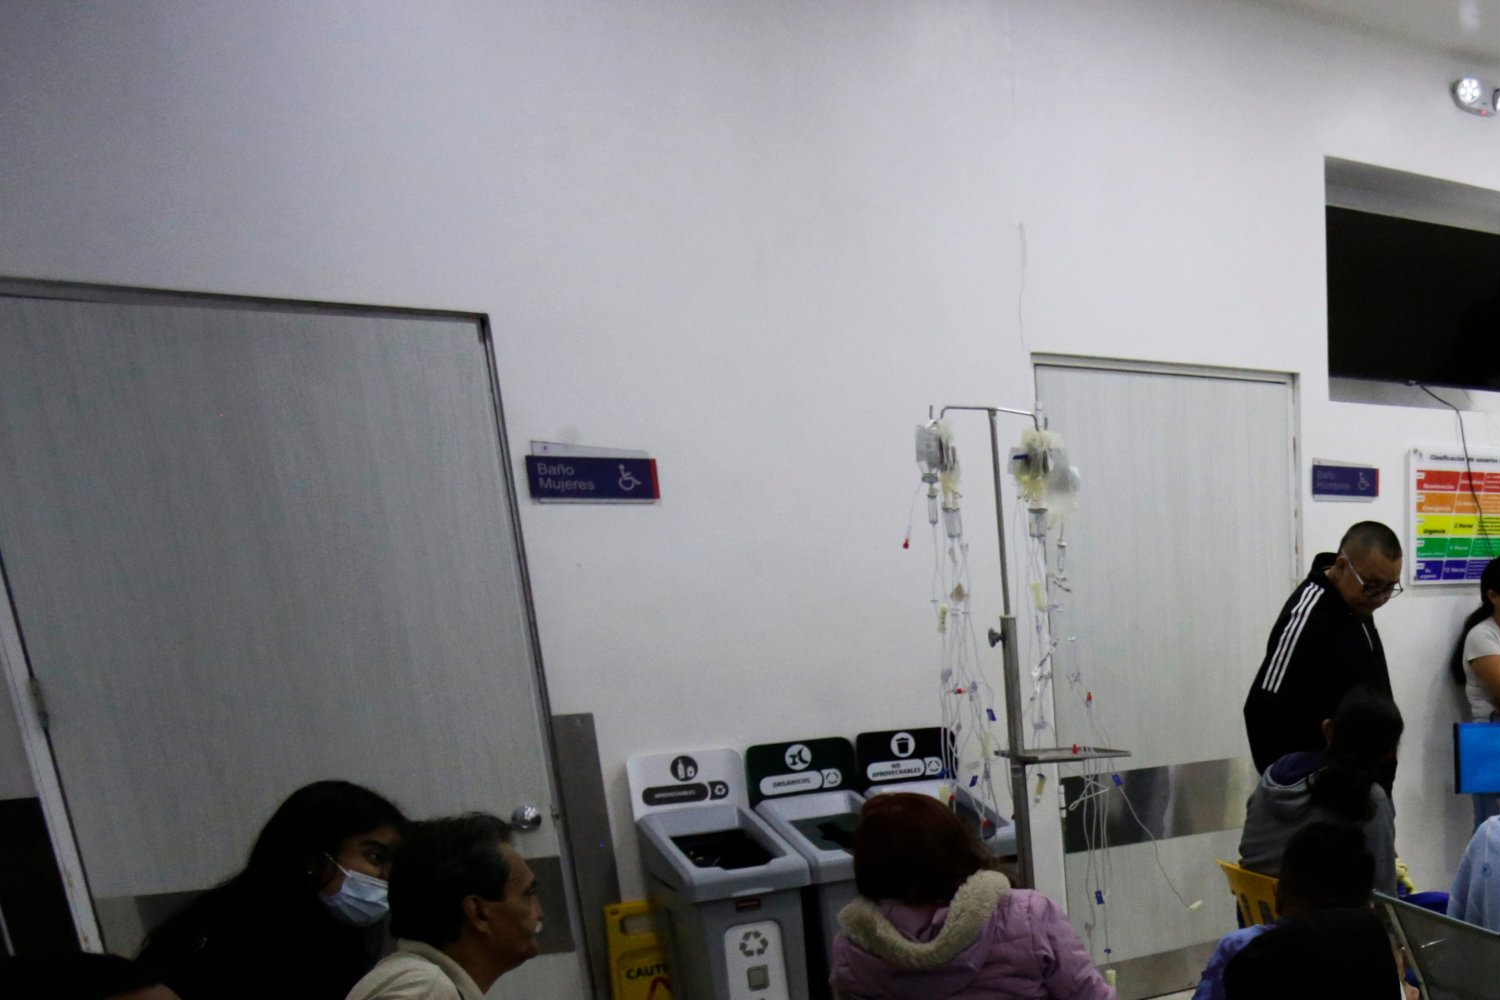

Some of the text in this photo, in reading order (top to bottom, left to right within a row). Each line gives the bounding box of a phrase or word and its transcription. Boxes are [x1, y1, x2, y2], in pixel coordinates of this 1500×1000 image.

[537, 462, 575, 477] Baño
[539, 477, 596, 493] Mujeres
[872, 767, 922, 779] APROVECHABLES
